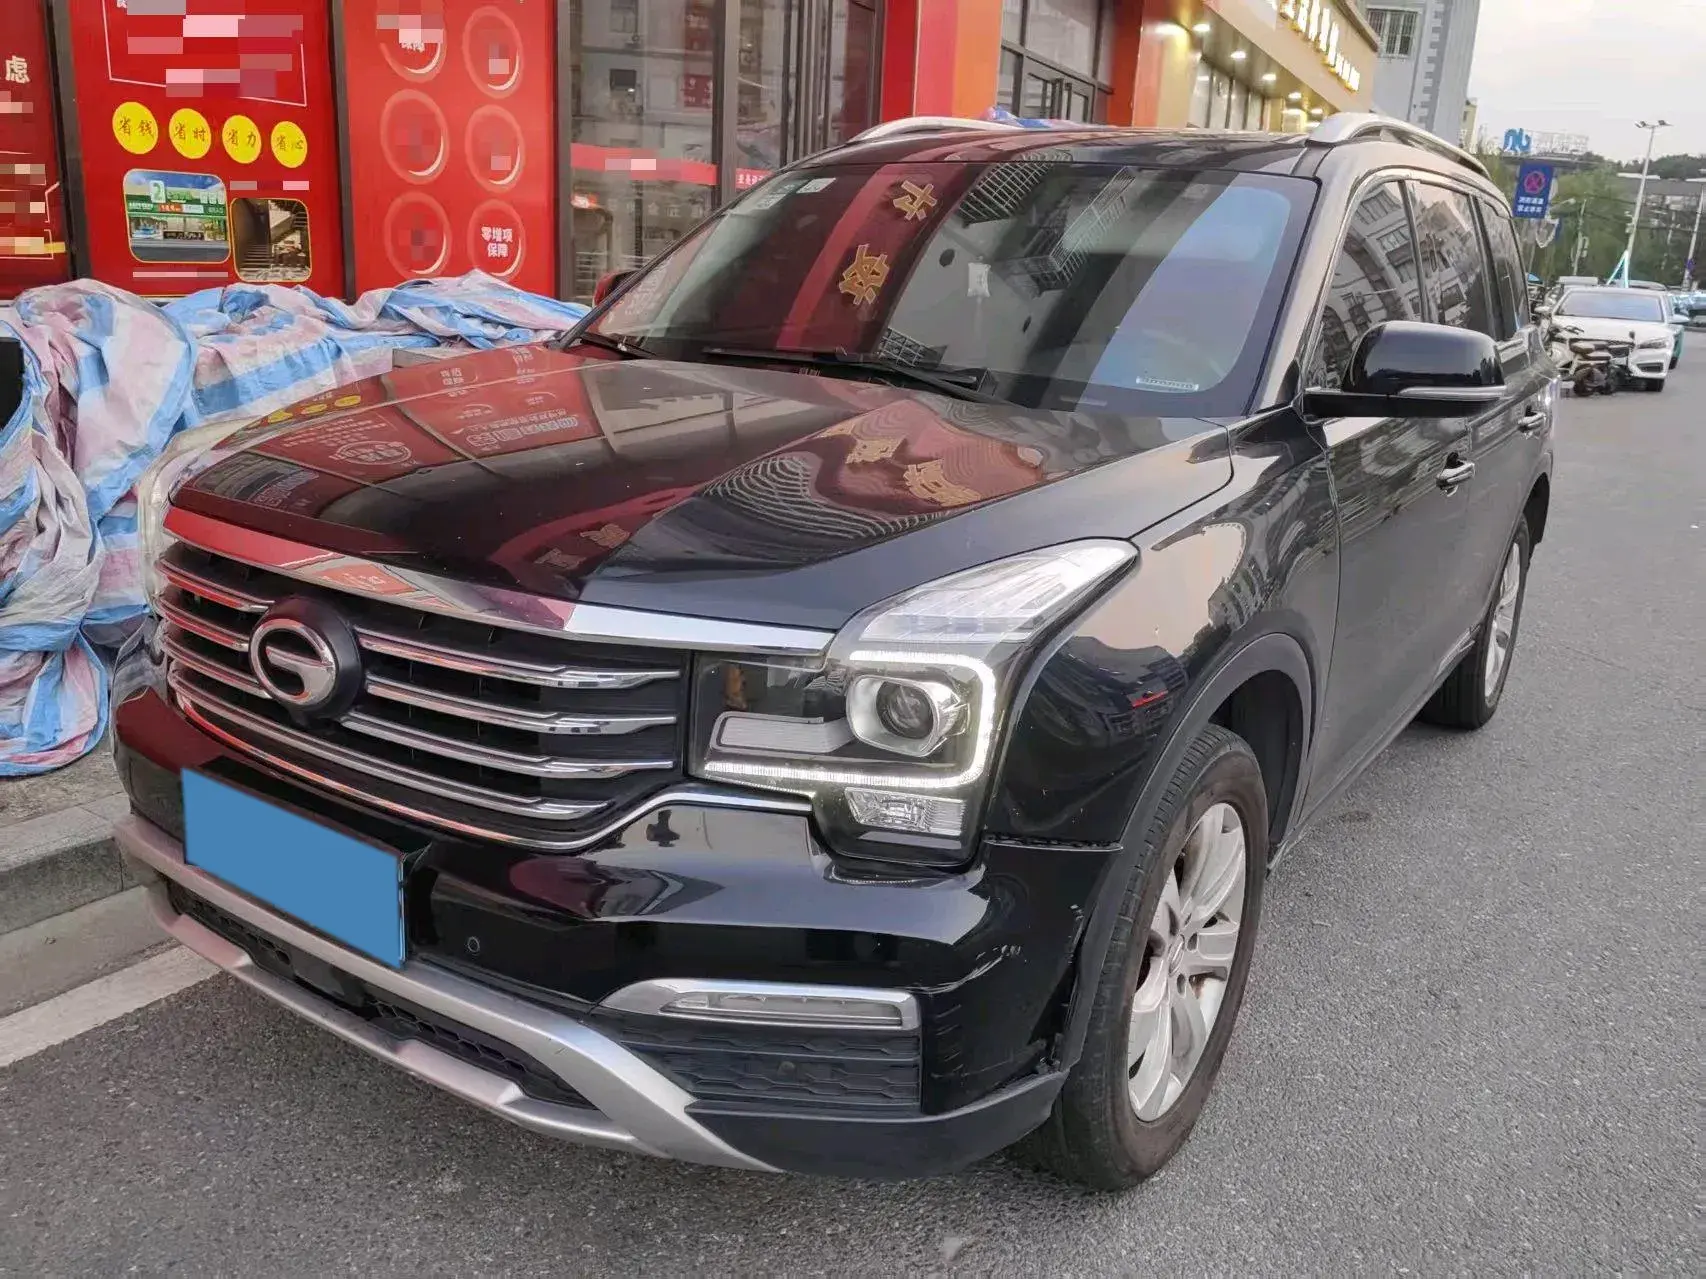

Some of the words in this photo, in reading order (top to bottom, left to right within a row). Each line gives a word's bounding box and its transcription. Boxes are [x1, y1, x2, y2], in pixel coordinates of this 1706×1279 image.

[5, 55, 30, 84] 虑
[119, 115, 154, 139] 省钱
[174, 122, 206, 142] 省时
[227, 129, 257, 147] 省力
[276, 134, 304, 151] 省心
[481, 226, 513, 243] 零增项
[487, 242, 509, 258] 保障
